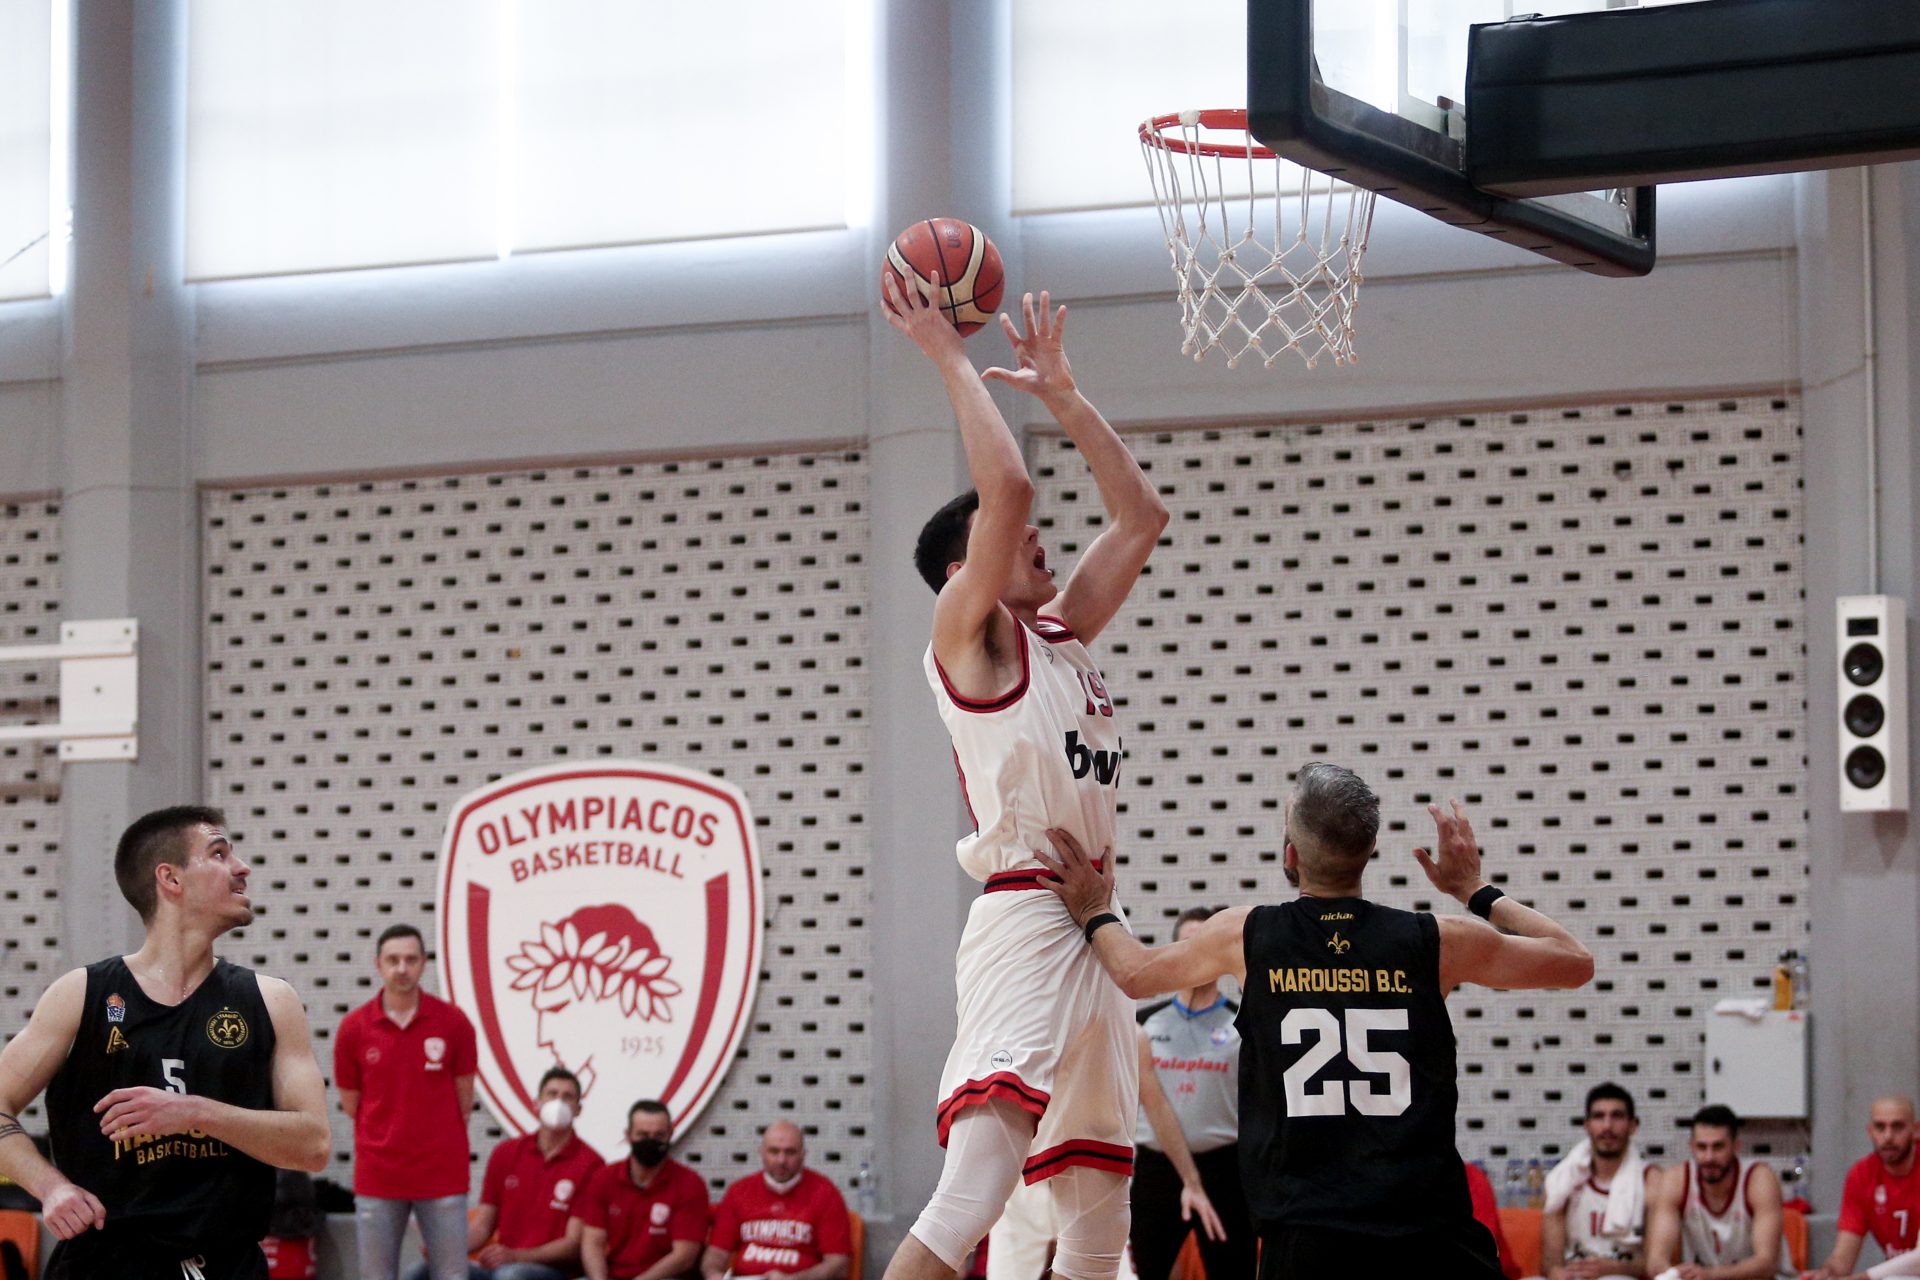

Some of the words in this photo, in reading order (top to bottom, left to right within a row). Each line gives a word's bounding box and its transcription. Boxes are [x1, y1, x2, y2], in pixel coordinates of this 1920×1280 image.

[1065, 730, 1122, 789] bwi
[476, 797, 718, 855] OLYMPIACOS
[511, 842, 684, 882] BASKETBALL
[1269, 968, 1370, 993] MAROUSSI
[1376, 969, 1413, 994] B.C.
[621, 1036, 664, 1057] 1925
[1280, 1007, 1412, 1117] 25
[161, 1058, 187, 1095] 5
[136, 1140, 228, 1165] BASKETBALL
[1892, 1209, 1908, 1237] 7
